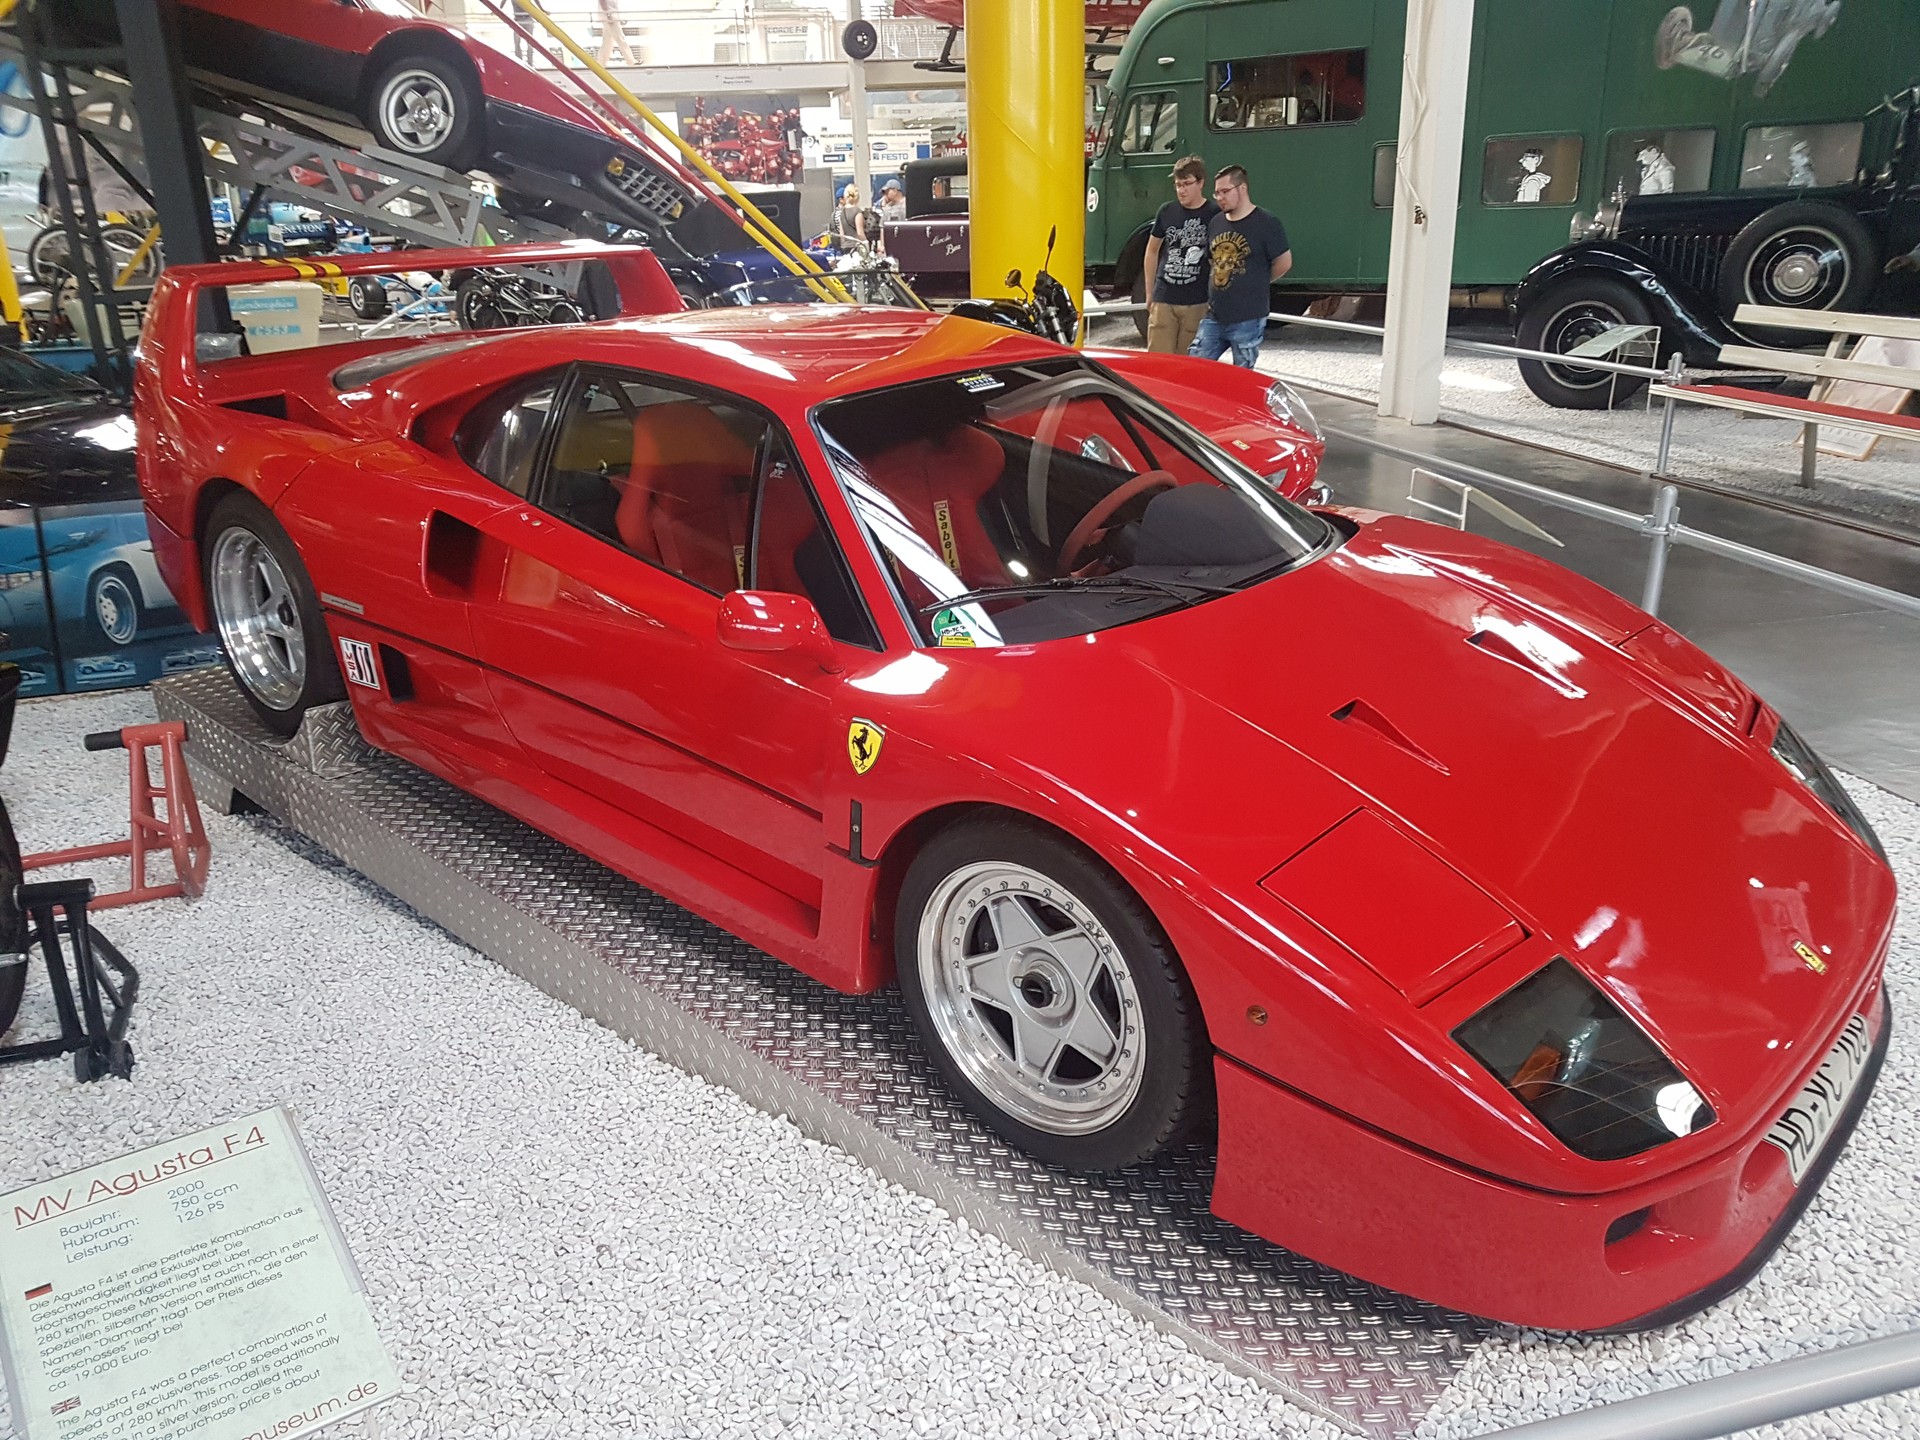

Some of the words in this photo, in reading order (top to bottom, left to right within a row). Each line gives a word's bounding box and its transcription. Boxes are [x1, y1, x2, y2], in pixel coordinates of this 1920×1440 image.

[938, 509, 955, 569] Sabelt
[344, 641, 358, 680] IMSA
[14, 1188, 72, 1226] MV
[87, 1146, 214, 1196] Agusta
[223, 1126, 266, 1155] F4
[59, 1209, 122, 1237] Baujahr:
[167, 1180, 205, 1199] 2000
[63, 1217, 139, 1250] Hubraum:
[171, 1195, 200, 1212] 750
[203, 1182, 239, 1200] ccm
[66, 1234, 133, 1264] Leistung:
[176, 1208, 204, 1223] 126
[207, 1200, 225, 1213] PS
[29, 1300, 50, 1312] Die
[53, 1283, 96, 1303] Agusta
[98, 1275, 113, 1287] F4
[115, 1270, 128, 1280] ist
[131, 1260, 157, 1274] eine
[160, 1242, 208, 1266] perfekte
[210, 1215, 281, 1245] Kombination
[283, 1207, 303, 1219] aus
[31, 1281, 131, 1322] Geschwindigkeit
[134, 1270, 158, 1285] und
[224, 1240, 243, 1252] Die
[37, 1330, 61, 1346] 280
[64, 1318, 99, 1335] km/h.
[102, 1304, 136, 1321] Diese
[139, 1281, 197, 1307] Maschine
[199, 1274, 211, 1284] ist
[214, 1262, 245, 1278] auch
[247, 1249, 278, 1266] noch
[279, 1244, 290, 1254] in
[292, 1233, 320, 1249] einer
[174, 1267, 200, 1281] liegt
[202, 1259, 222, 1272] bei
[40, 1329, 101, 1357] speziellen
[104, 1307, 159, 1332] silbernen
[160, 1290, 203, 1310] Version
[263, 1260, 282, 1272] die
[284, 1250, 308, 1264] den
[42, 1345, 92, 1369] Namen
[194, 1296, 216, 1310] Der
[217, 1287, 244, 1301] Preis
[246, 1271, 283, 1290] dieses
[133, 1330, 160, 1346] liegt
[163, 1321, 183, 1334] bei
[48, 1380, 70, 1392] ca.
[75, 1358, 119, 1382] 19.000
[121, 1348, 152, 1364] Euro.
[56, 1415, 80, 1429] The
[83, 1396, 129, 1419] Agusta
[131, 1387, 147, 1399] F4
[150, 1376, 175, 1391] was
[177, 1372, 187, 1380] a
[190, 1351, 235, 1377] perfect
[238, 1320, 314, 1356] combination
[315, 1312, 328, 1324] of
[60, 1418, 103, 1440] speed
[106, 1406, 133, 1423] and
[136, 1371, 222, 1411] exclusiveness.
[225, 1361, 247, 1373] Top
[250, 1342, 289, 1364] speed
[291, 1333, 314, 1347] was
[315, 1327, 327, 1337] in
[112, 1422, 124, 1435] of
[128, 1411, 153, 1429] 280
[155, 1398, 191, 1416] km/h.
[193, 1386, 216, 1400] This
[219, 1367, 260, 1390] model
[261, 1364, 271, 1373] is
[273, 1334, 340, 1368] additionally
[146, 1426, 156, 1435] a
[159, 1411, 189, 1430] silver
[192, 1392, 239, 1415] version,
[241, 1372, 281, 1395] called
[282, 1364, 303, 1377] the
[176, 1406, 236, 1438] purchase
[238, 1391, 271, 1411] price
[273, 1387, 283, 1396] is
[284, 1369, 321, 1390] about
